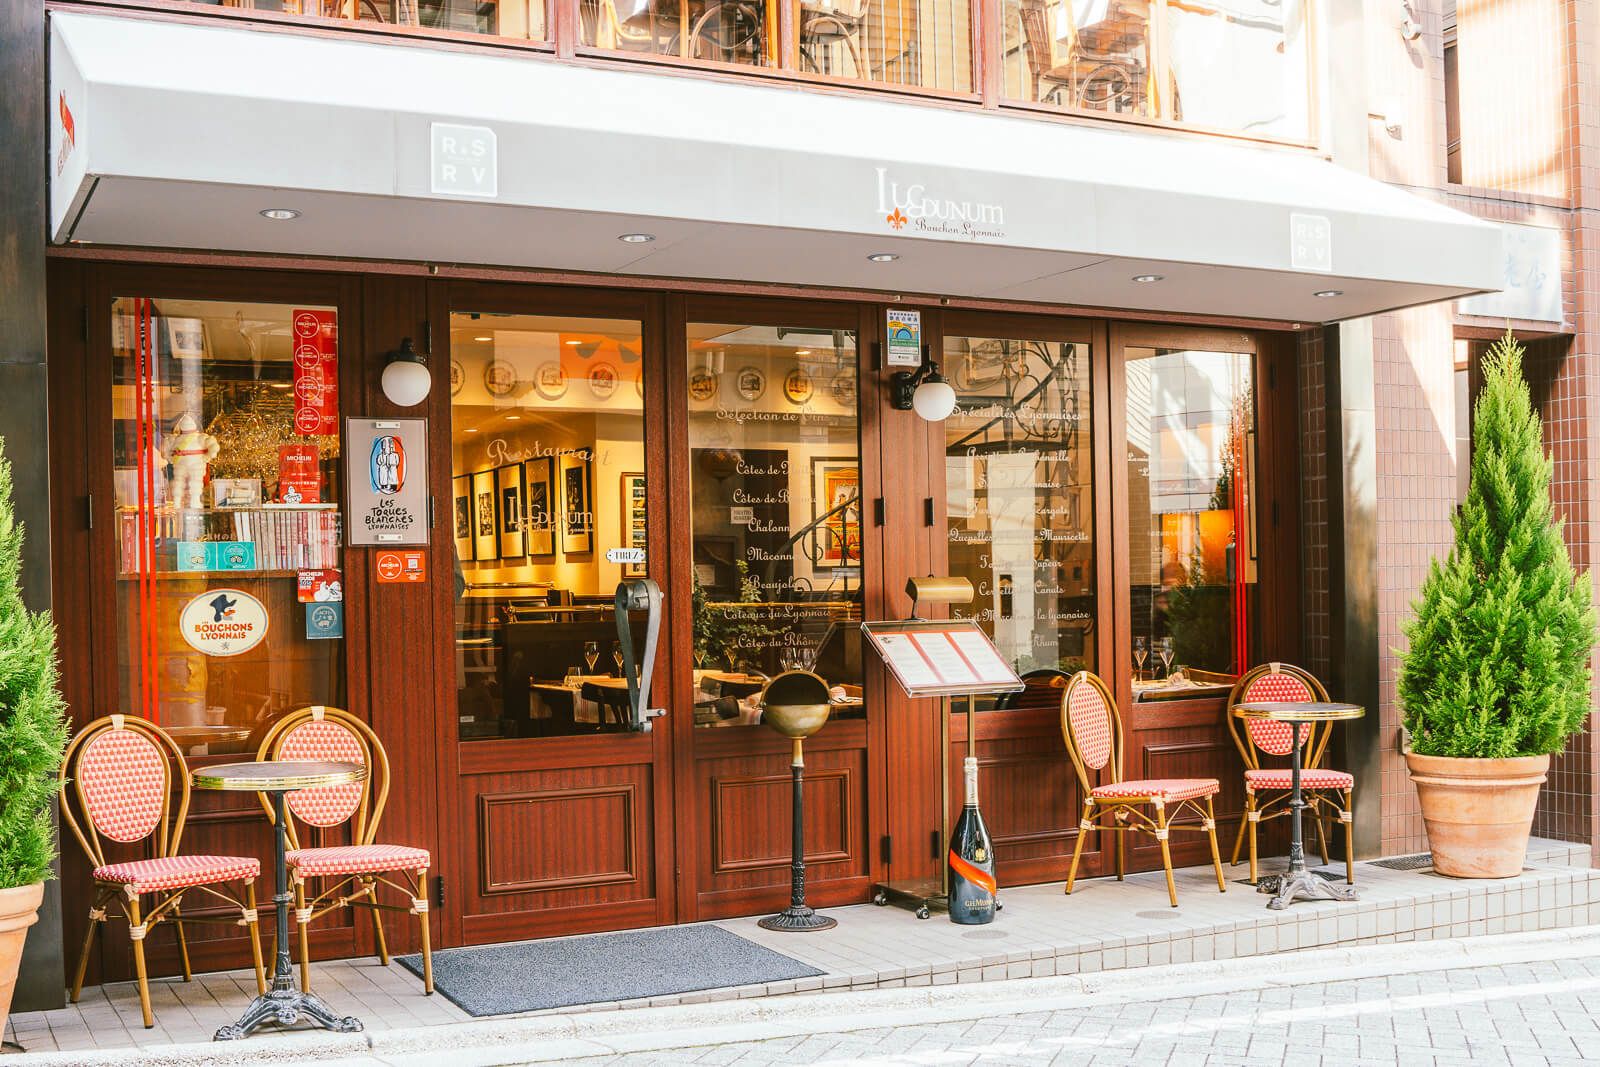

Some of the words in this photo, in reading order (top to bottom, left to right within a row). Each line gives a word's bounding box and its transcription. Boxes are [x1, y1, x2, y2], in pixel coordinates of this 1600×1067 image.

[782, 412, 800, 421] de
[736, 460, 767, 475] Côtes
[767, 465, 781, 475] de
[733, 488, 764, 503] Côtes
[764, 492, 778, 503] de
[1033, 579, 1066, 595] Canuts
[783, 603, 831, 623] Lyonnais
[194, 622, 254, 632] BOUCHONS
[200, 632, 247, 641] LYONNAIS
[738, 633, 768, 649] Côtes
[769, 636, 784, 648] du
[784, 632, 821, 648] Rhône
